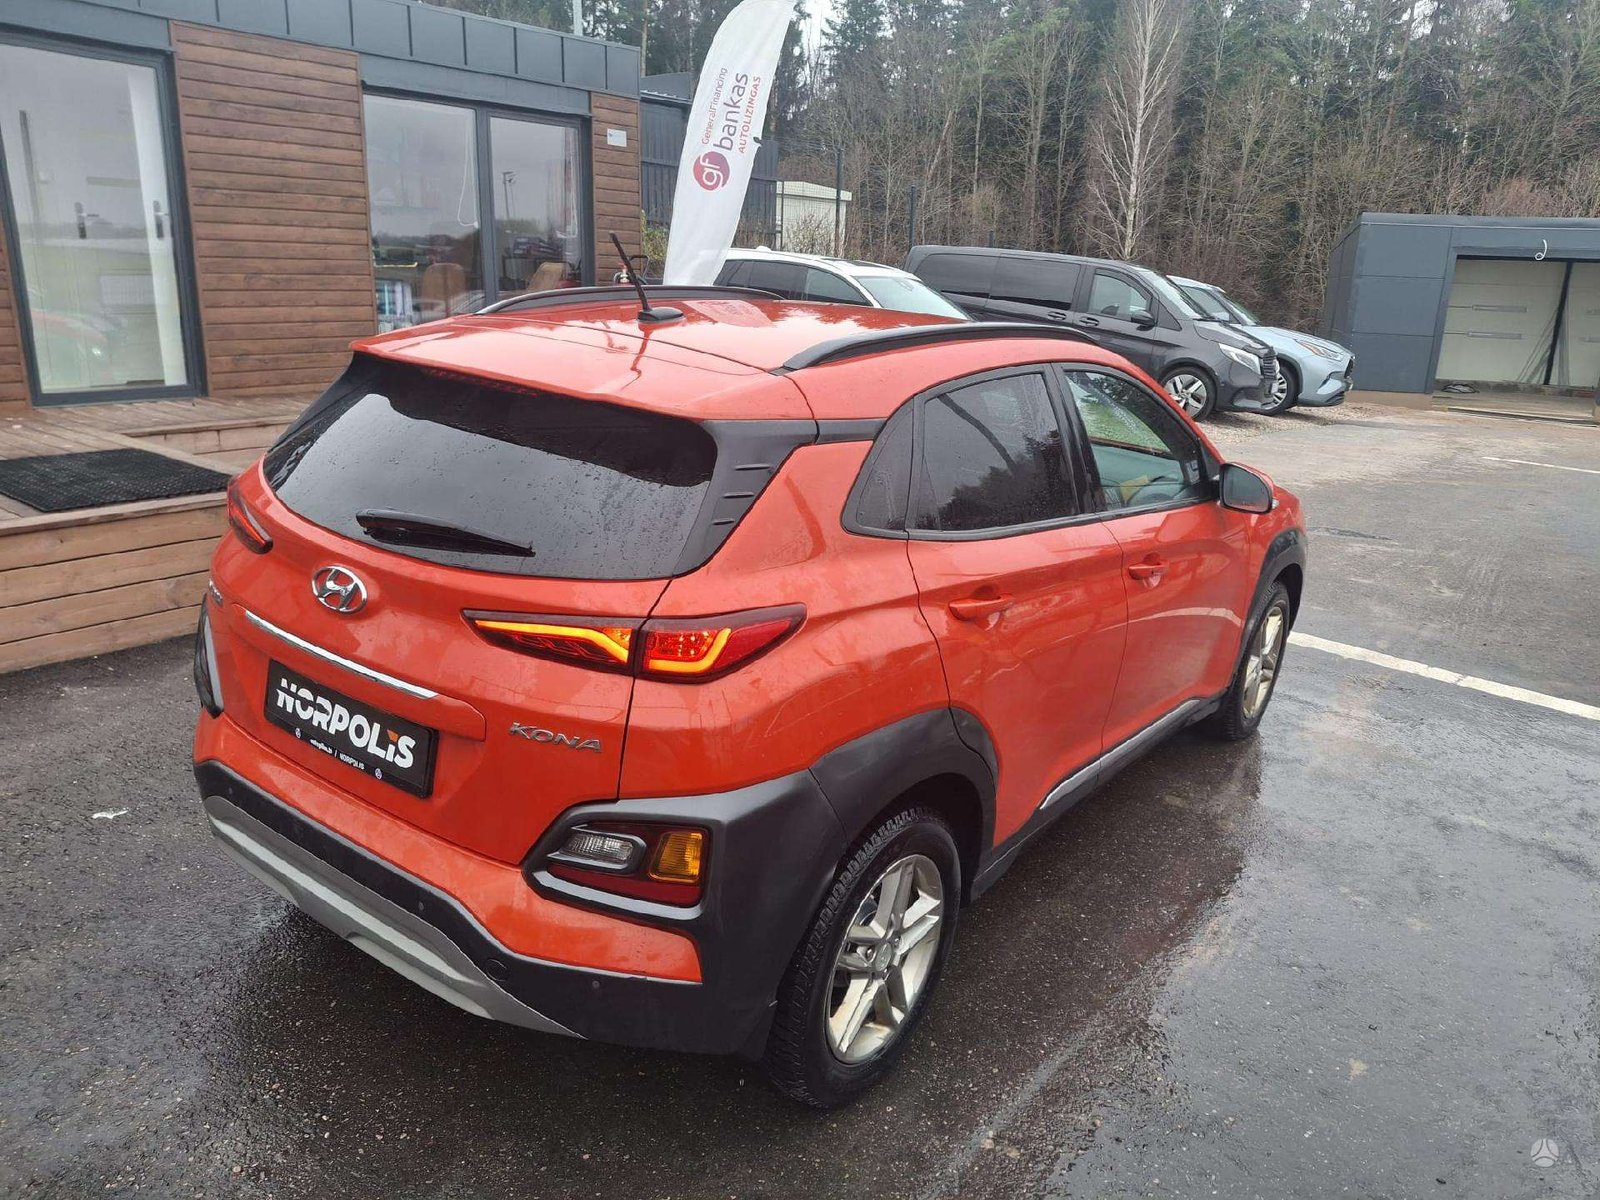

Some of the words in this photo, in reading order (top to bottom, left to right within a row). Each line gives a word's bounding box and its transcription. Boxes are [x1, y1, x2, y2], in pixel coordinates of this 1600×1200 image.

[702, 67, 728, 145] GeneralFinancing
[713, 73, 748, 151] bankas
[738, 76, 761, 153] AUTOLIZINGAS
[509, 721, 602, 753] KONA
